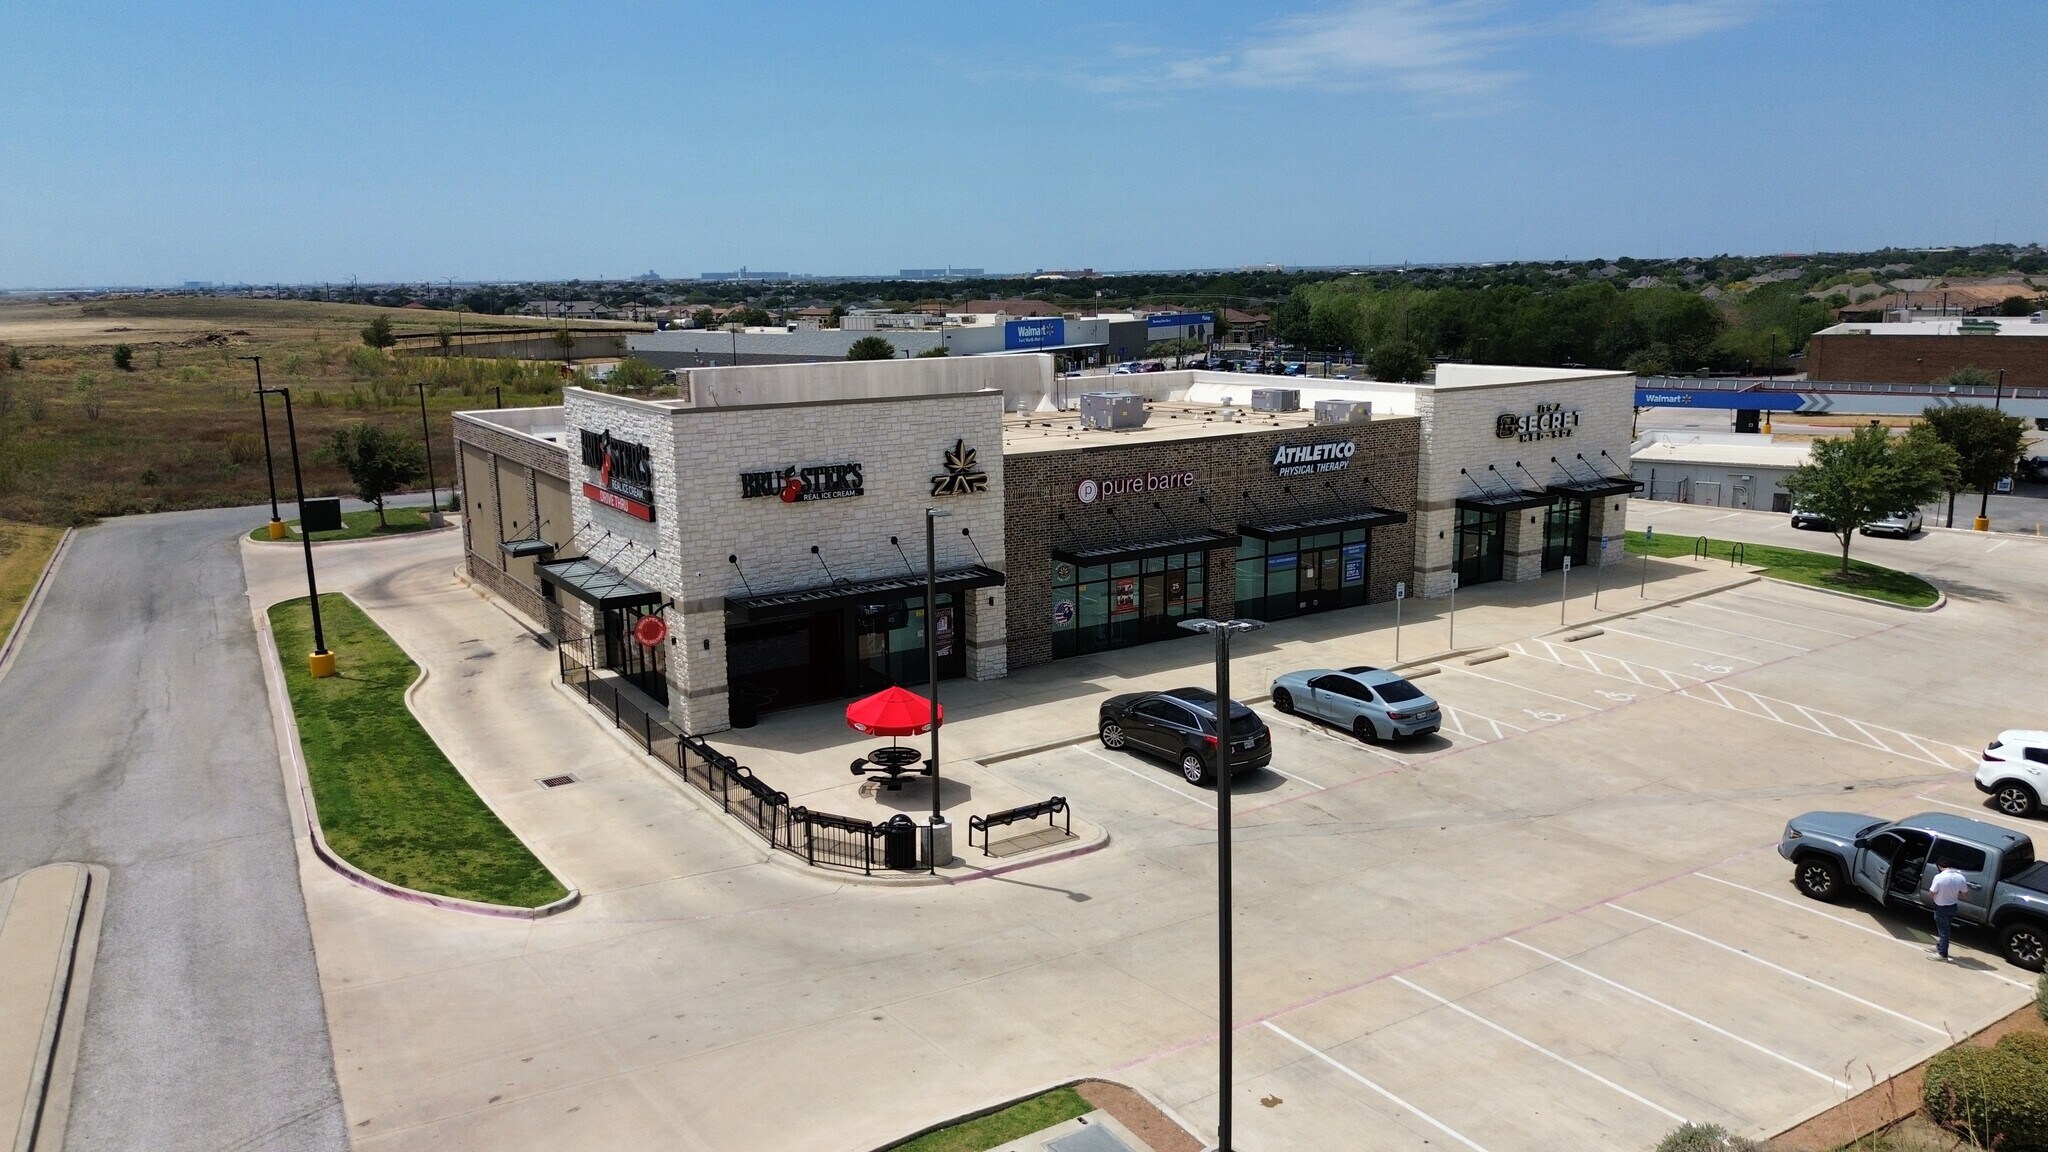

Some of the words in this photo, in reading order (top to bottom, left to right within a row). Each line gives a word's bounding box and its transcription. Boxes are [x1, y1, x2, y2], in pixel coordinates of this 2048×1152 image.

[1017, 325, 1046, 337] Walmart
[1646, 394, 1681, 403] Walmart
[1518, 411, 1583, 433] SECRET
[1273, 442, 1356, 465] ATHLETICO
[1279, 464, 1314, 477] PHYSICAL
[1316, 460, 1349, 473] THERAPY
[612, 479, 622, 491] REAL
[931, 472, 989, 497] ZAR
[1102, 478, 1143, 500] pure
[1147, 472, 1194, 491] barre
[599, 490, 615, 507] DRIVE
[614, 496, 629, 512] THRU
[803, 492, 820, 500] REAL
[832, 490, 855, 498] CREAM
